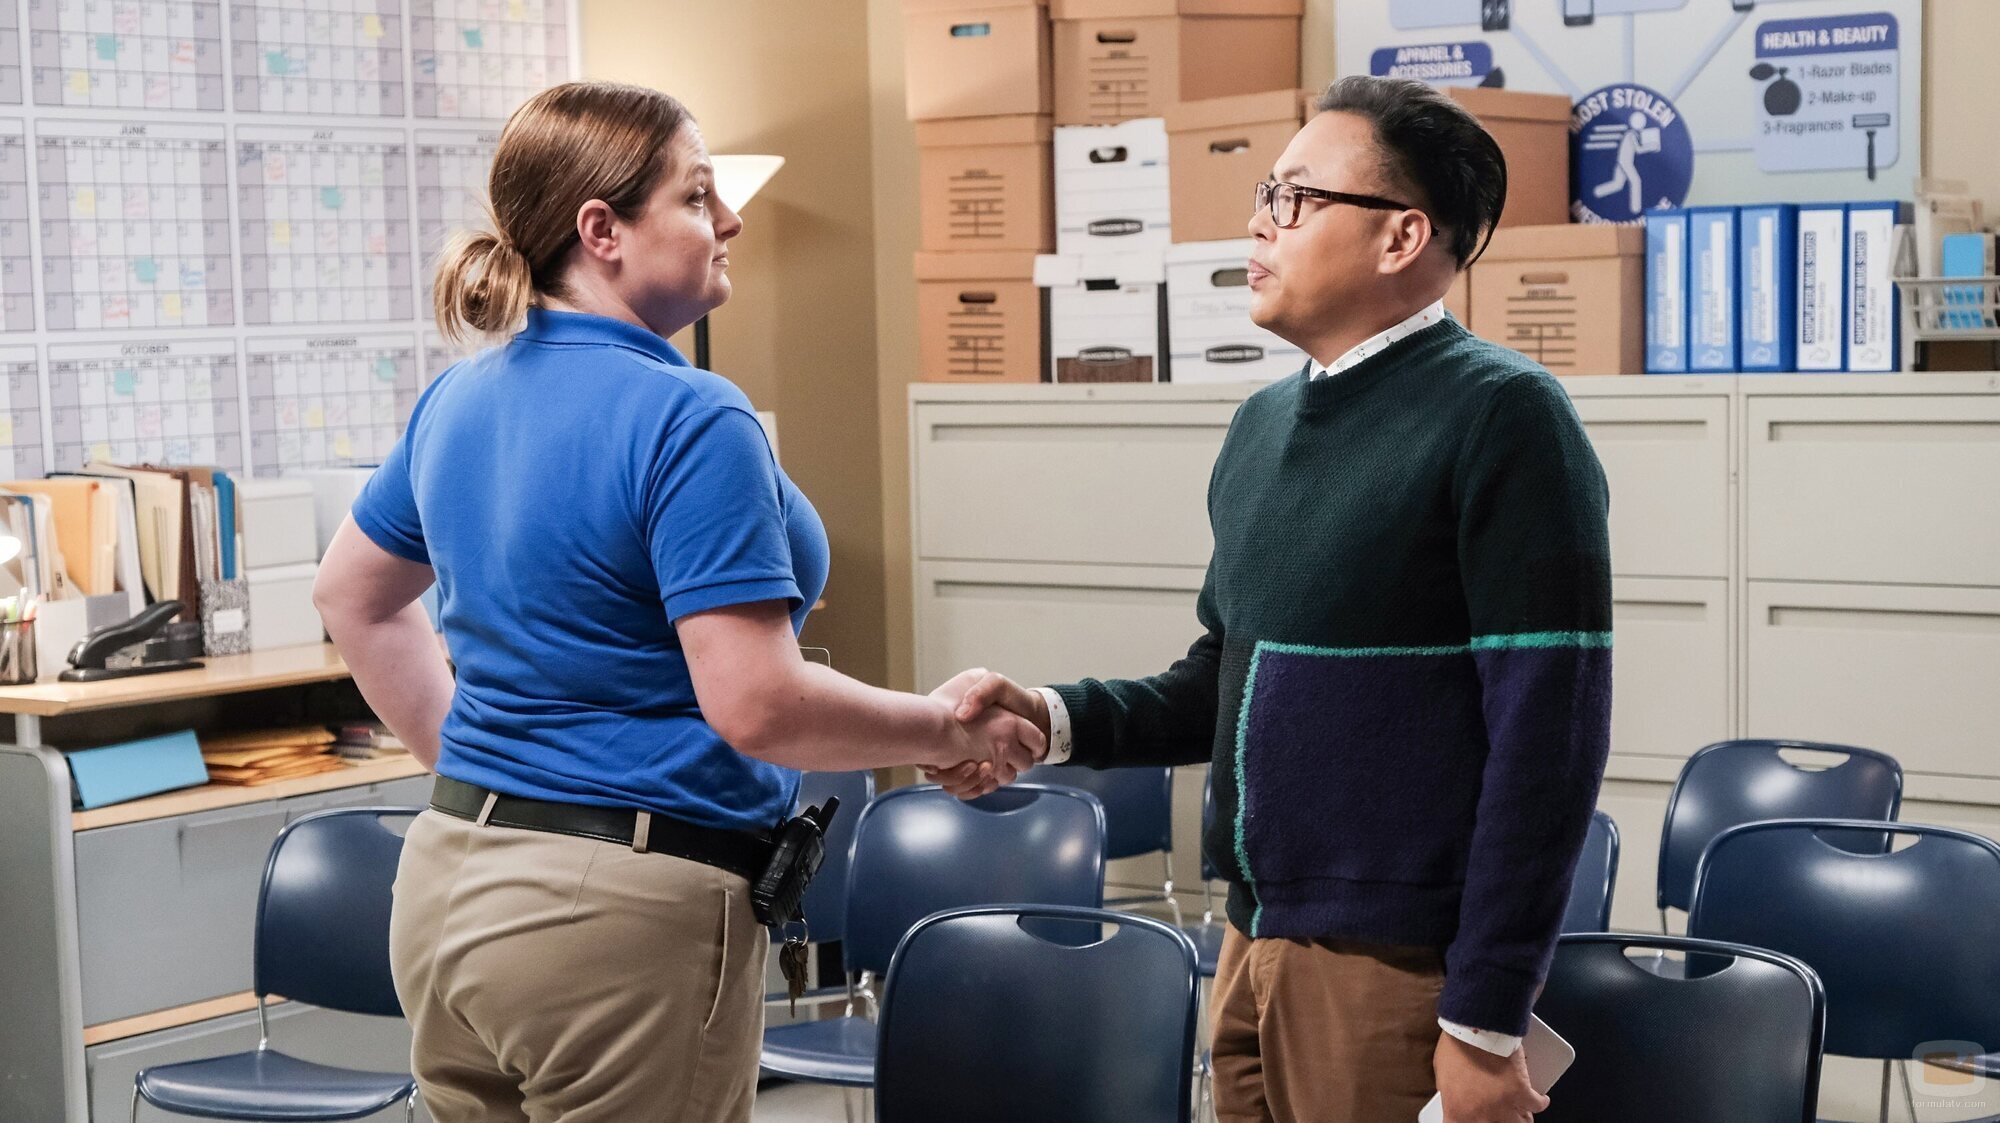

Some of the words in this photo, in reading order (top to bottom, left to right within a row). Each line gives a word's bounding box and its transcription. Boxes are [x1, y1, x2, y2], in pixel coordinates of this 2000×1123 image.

[1762, 30, 1816, 50] HEALTH
[1818, 29, 1831, 46] &
[1832, 24, 1889, 46] BEAUTY
[1395, 45, 1452, 65] APPAREL
[1452, 44, 1465, 61] &
[1388, 60, 1473, 79] ACCESSORIES
[1800, 65, 1845, 79] 1-Razor
[1850, 61, 1893, 76] Blades
[1808, 89, 1877, 105] 2-Make-up
[1611, 88, 1677, 128] STOLEN
[1763, 118, 1845, 136] 3-Fragrances
[120, 344, 170, 356] OCTOBER
